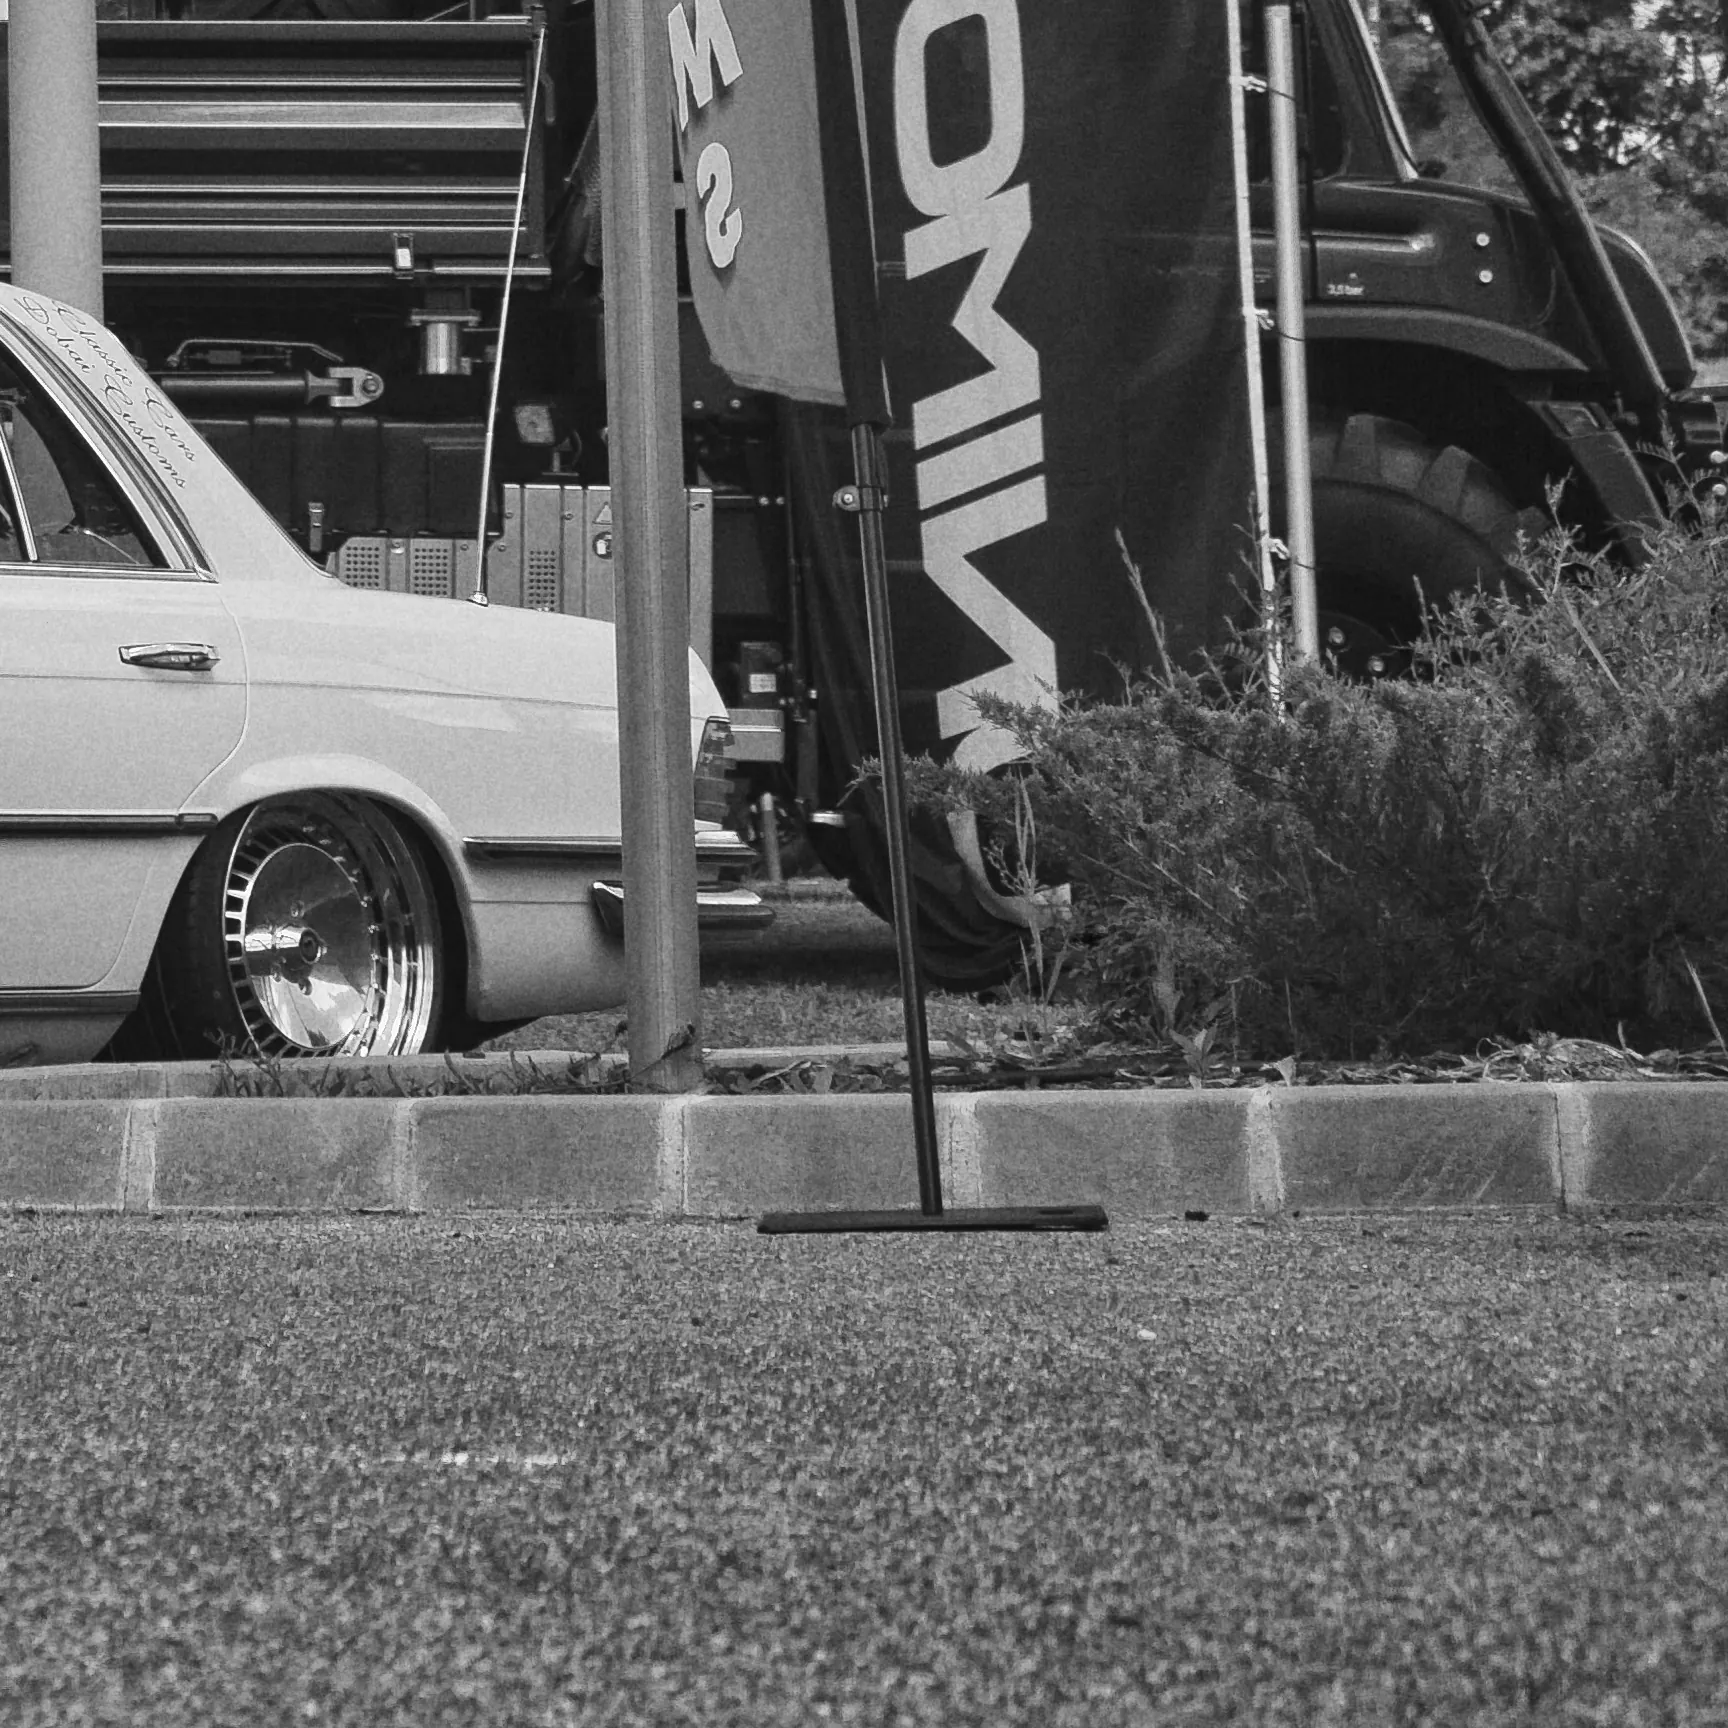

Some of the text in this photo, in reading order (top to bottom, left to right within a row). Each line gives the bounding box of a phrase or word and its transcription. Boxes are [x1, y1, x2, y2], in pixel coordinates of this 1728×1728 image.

[14, 296, 186, 489] Dobai Customs
[52, 300, 196, 462] Classic Cars
